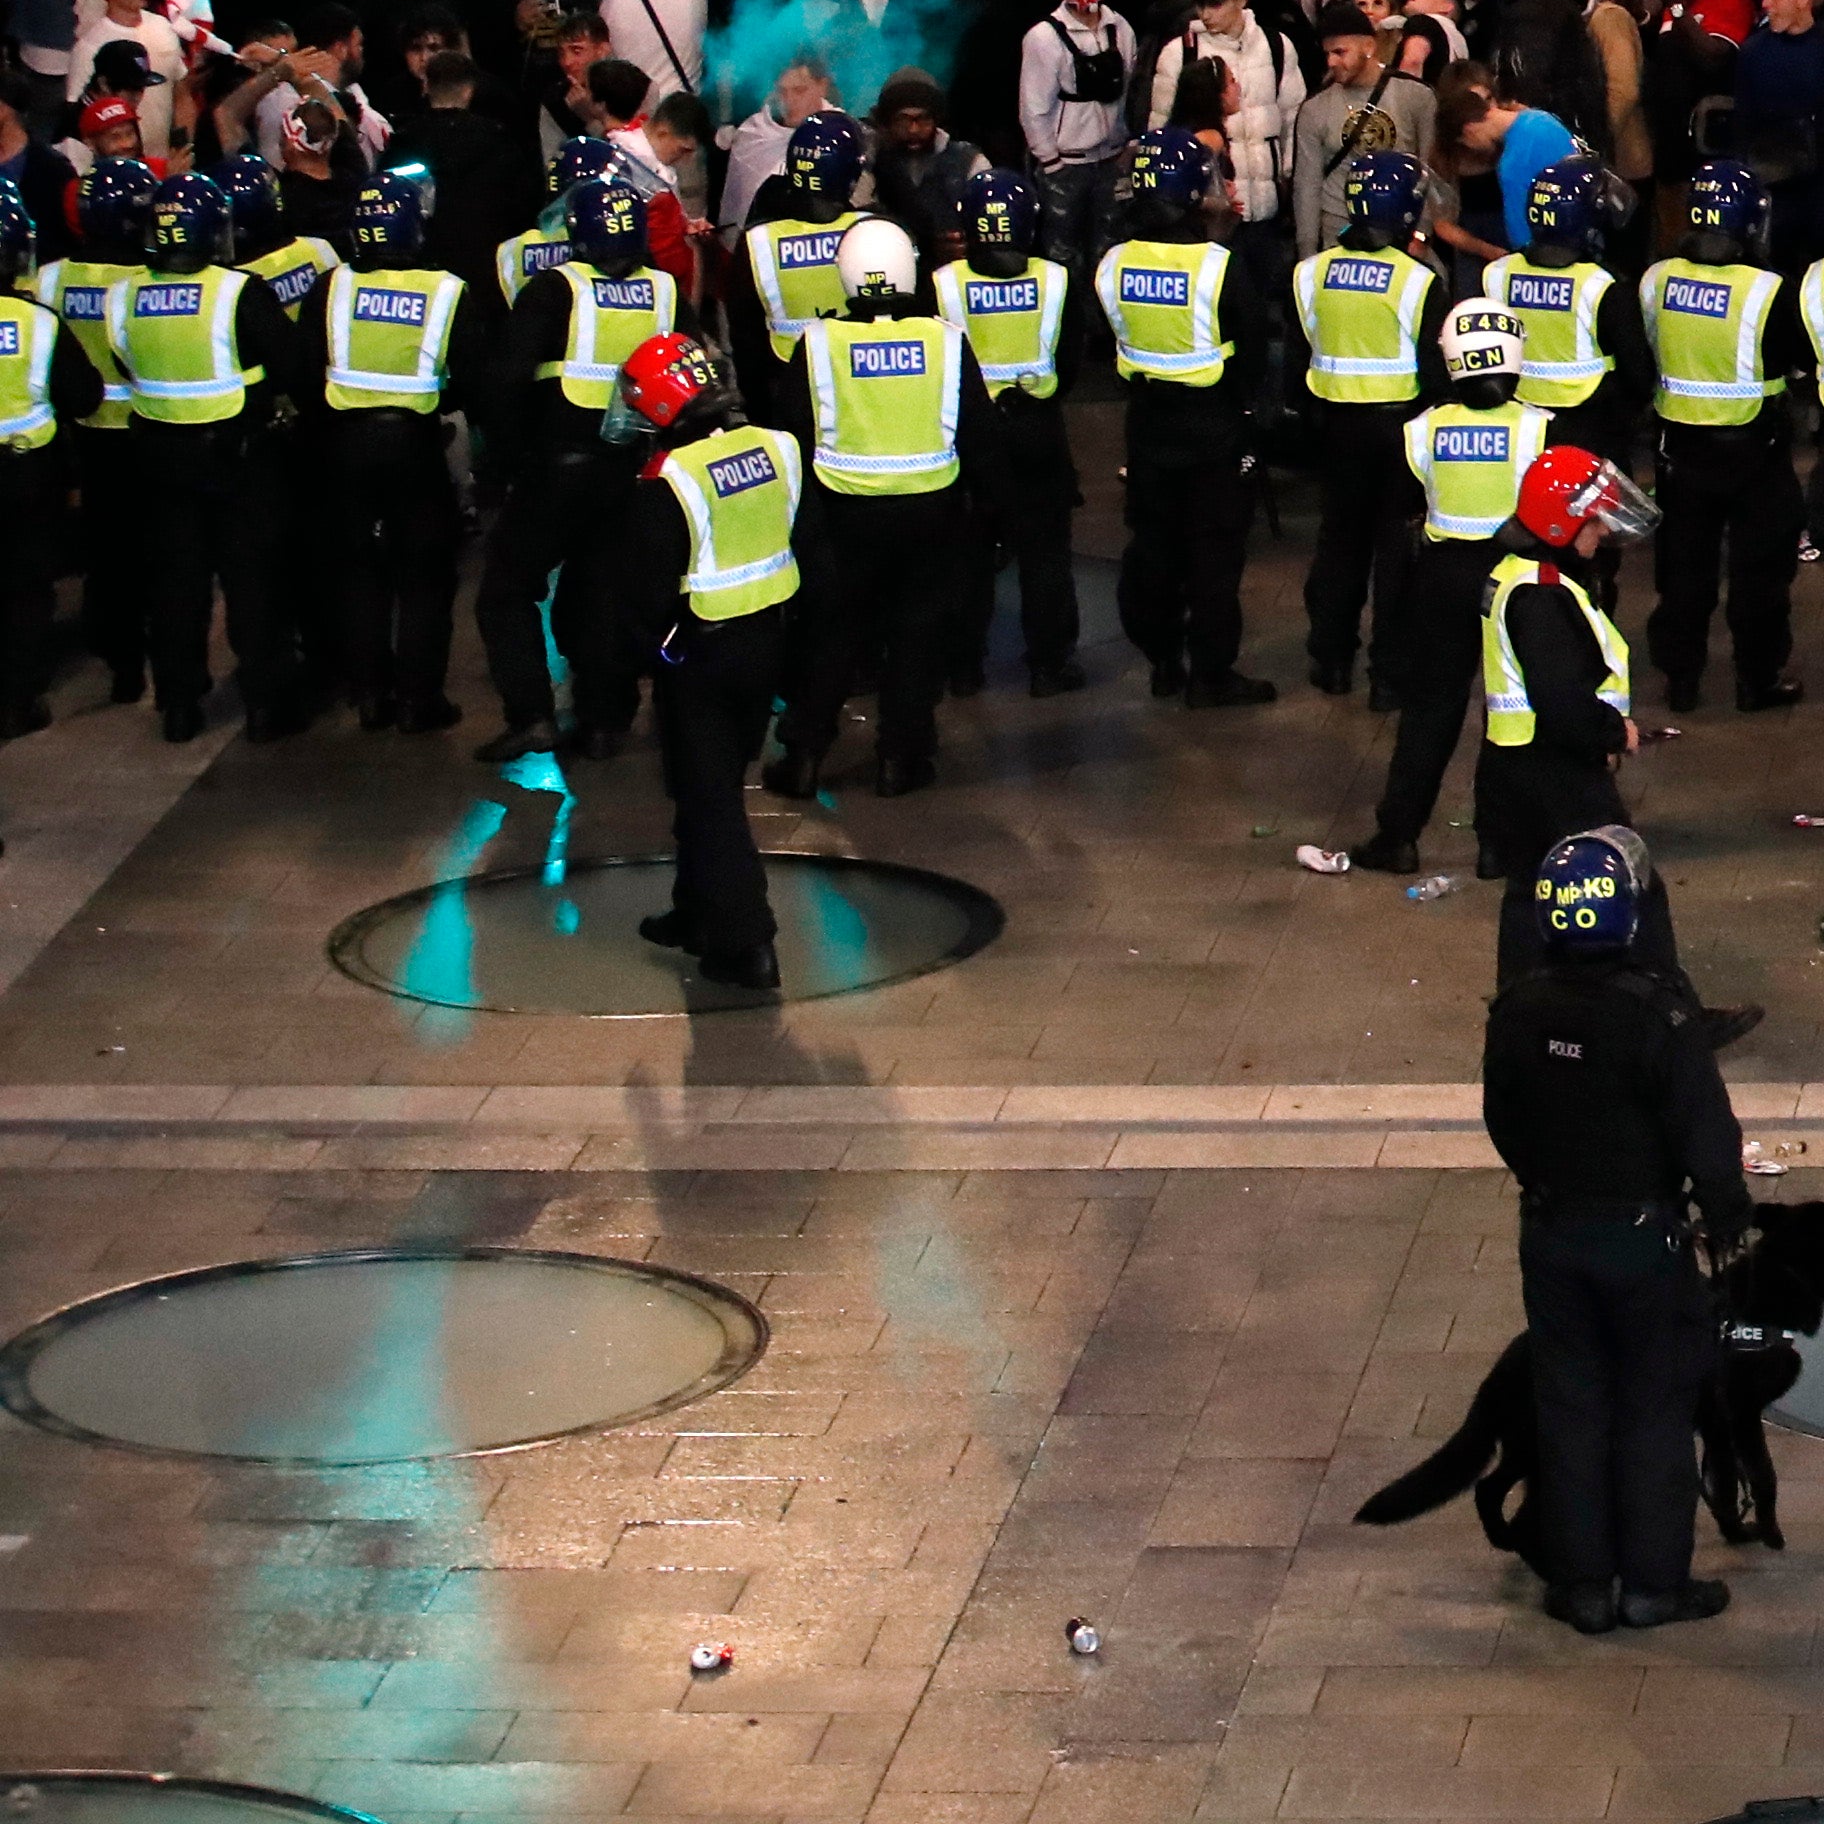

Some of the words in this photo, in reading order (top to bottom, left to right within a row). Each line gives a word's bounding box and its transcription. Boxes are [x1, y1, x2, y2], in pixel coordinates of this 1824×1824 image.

[796, 160, 815, 171] MP
[1134, 157, 1150, 169] MP
[360, 189, 382, 201] MP
[1348, 184, 1363, 194] MP
[1534, 193, 1551, 205] MP
[612, 199, 632, 214] MP
[986, 202, 1009, 215] MP
[158, 214, 177, 226] MP
[865, 272, 887, 285] MP
[1122, 272, 1187, 301] POLICE
[1326, 262, 1391, 290] POLICE
[136, 285, 201, 314] POLICE
[595, 282, 654, 307] POLICE
[968, 283, 1037, 310] POLICE
[1510, 277, 1572, 307] POLICE
[1665, 280, 1729, 312] POLICE
[355, 291, 425, 322] POLICE
[1457, 315, 1519, 333] 8487
[852, 345, 924, 372] POLICE
[1467, 349, 1503, 370] CN
[1435, 431, 1506, 457] POLICE
[712, 451, 774, 492] POLICE
[1583, 877, 1615, 900] K9
[1551, 908, 1597, 930] CO
[1549, 1039, 1583, 1059] POLICE
